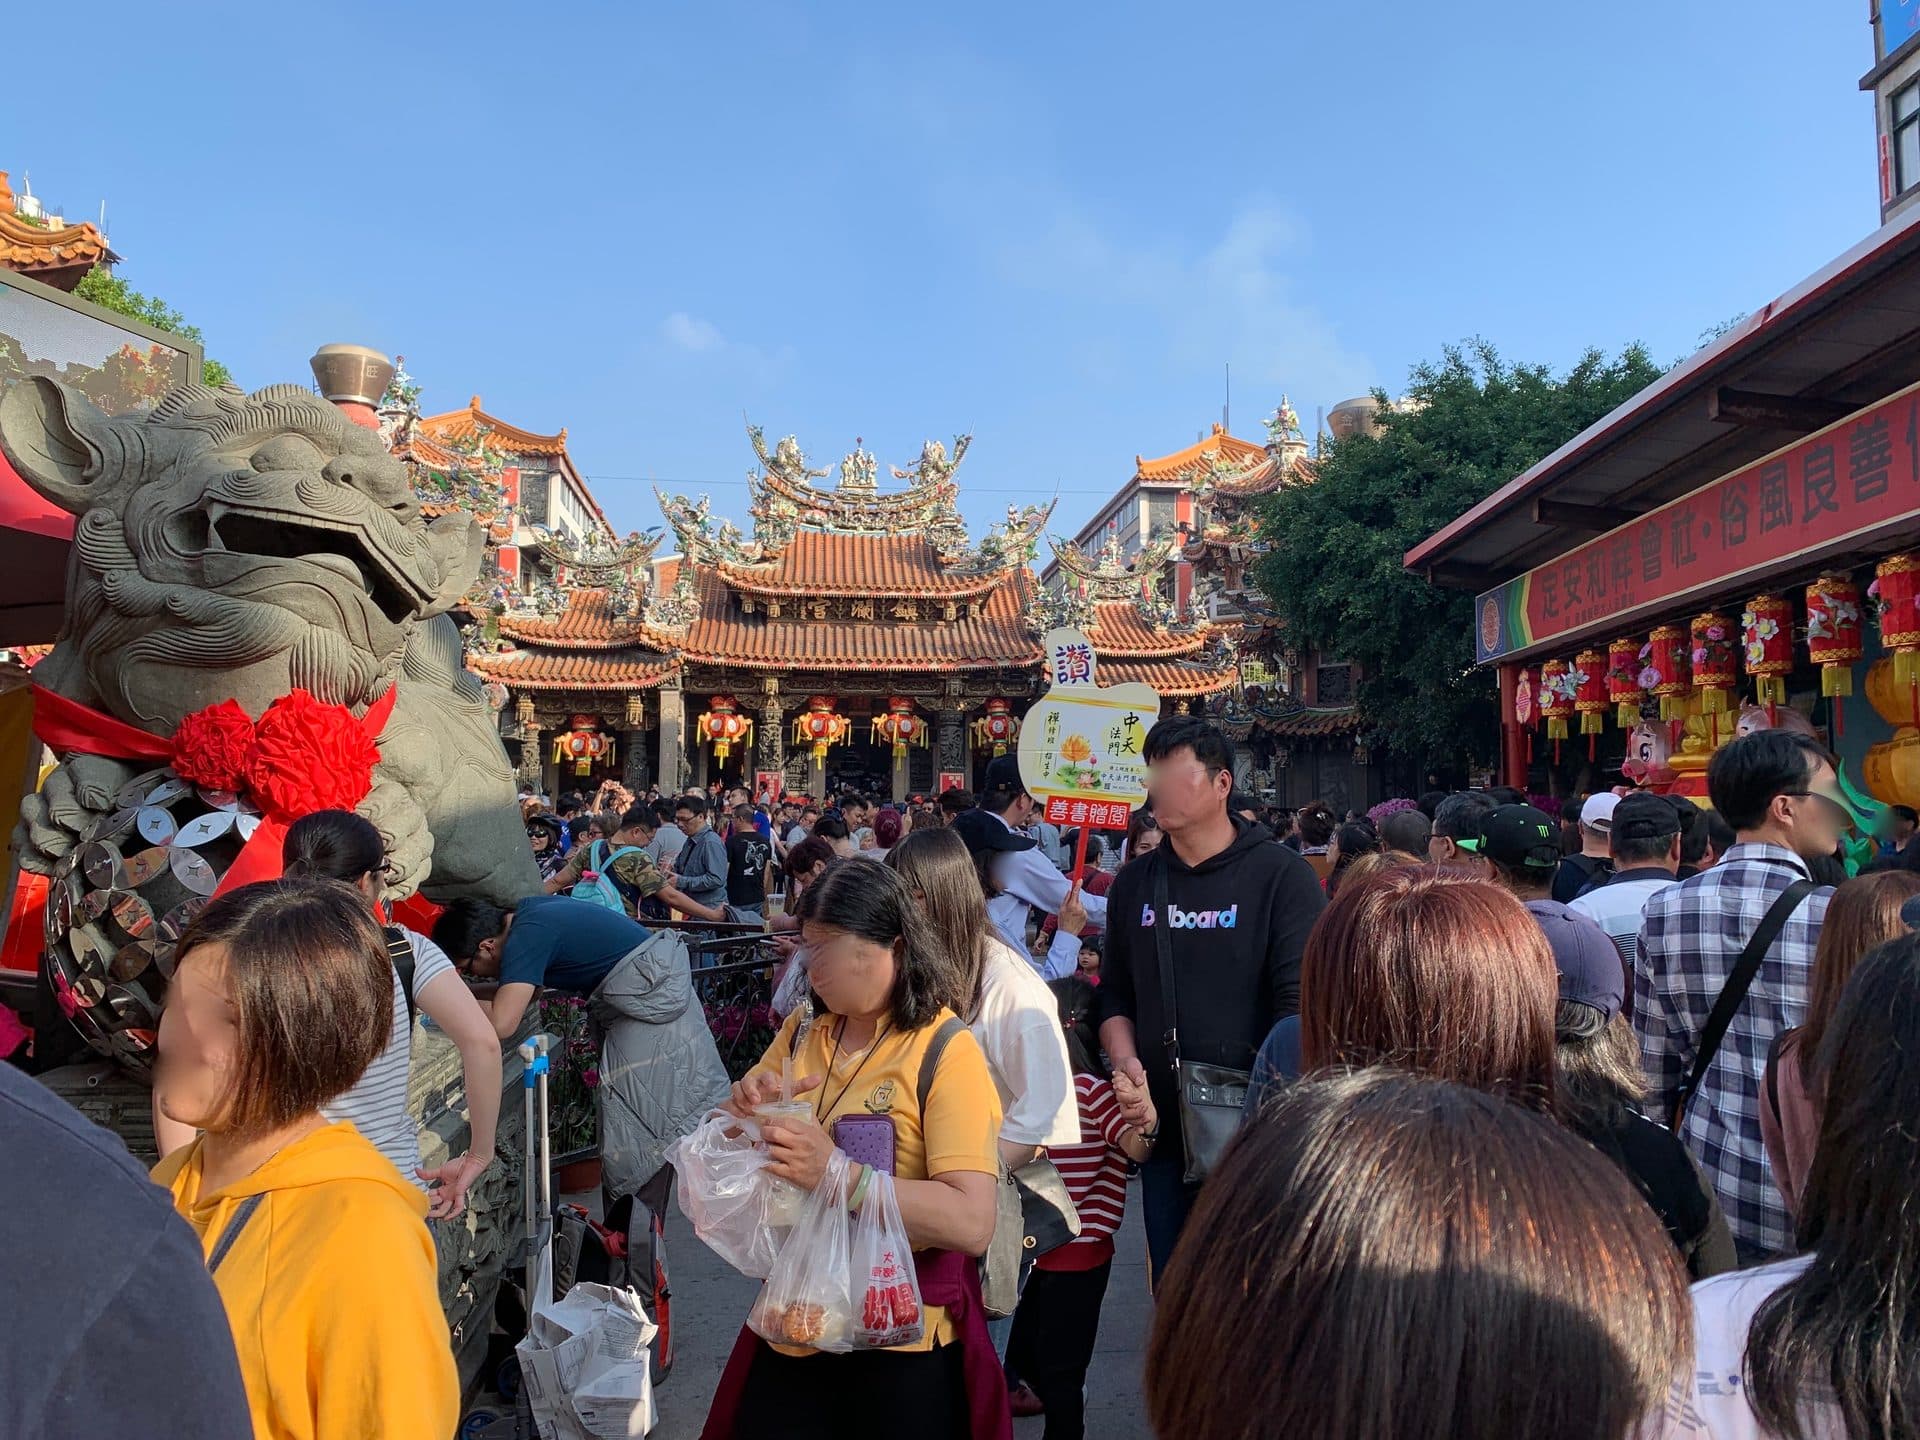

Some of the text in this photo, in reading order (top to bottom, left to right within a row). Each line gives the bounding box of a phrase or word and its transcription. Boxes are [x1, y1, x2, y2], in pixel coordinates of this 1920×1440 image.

[1055, 643, 1091, 684] 讚
[1049, 799, 1127, 826] 善書贈閱
[1140, 903, 1238, 929] blboard
